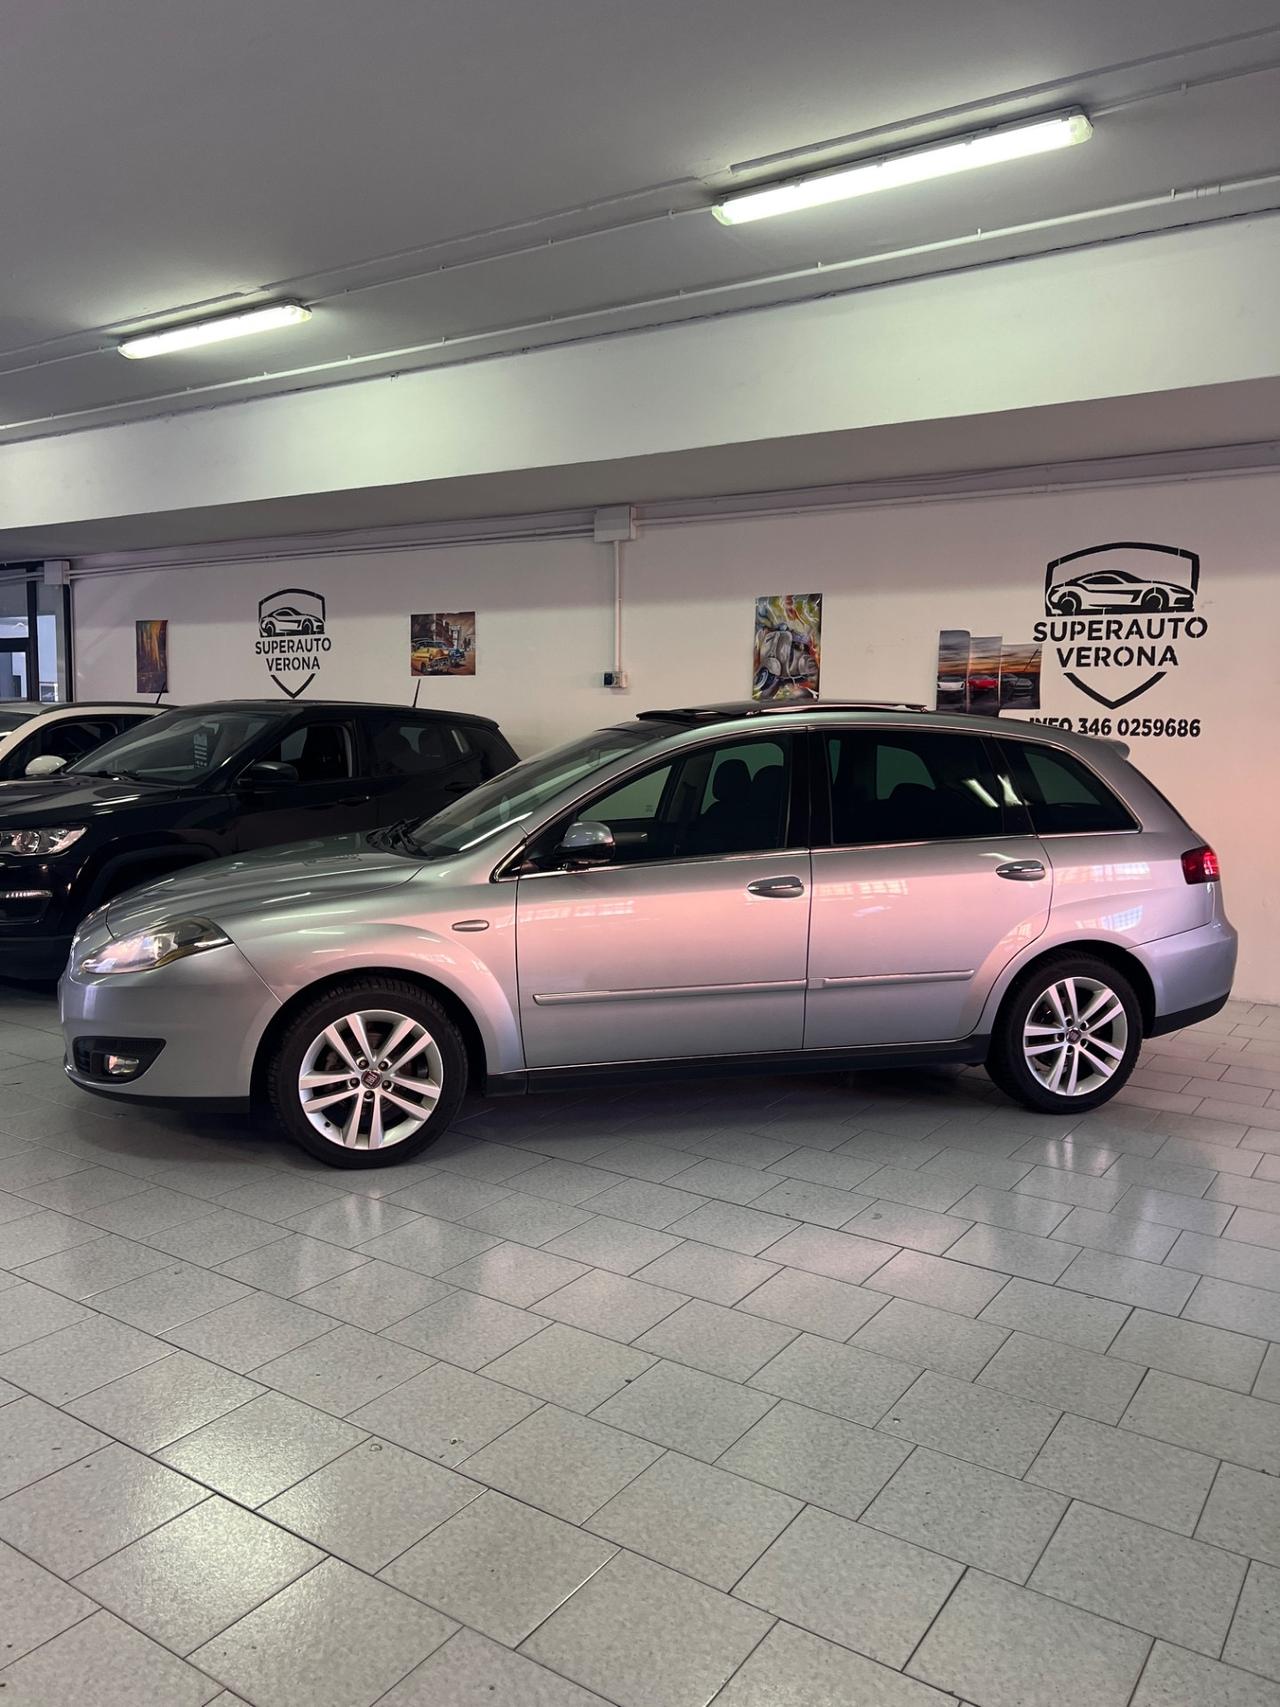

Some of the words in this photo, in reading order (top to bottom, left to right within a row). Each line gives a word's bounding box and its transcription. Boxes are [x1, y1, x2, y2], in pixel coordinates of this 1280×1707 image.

[1033, 616, 1208, 642] SUPERAUTO
[255, 637, 332, 655] SUPERAUTO
[1056, 645, 1179, 668] VERONA
[266, 656, 321, 672] VERONA
[1078, 717, 1112, 736] 346
[1117, 718, 1201, 738] 0259686
